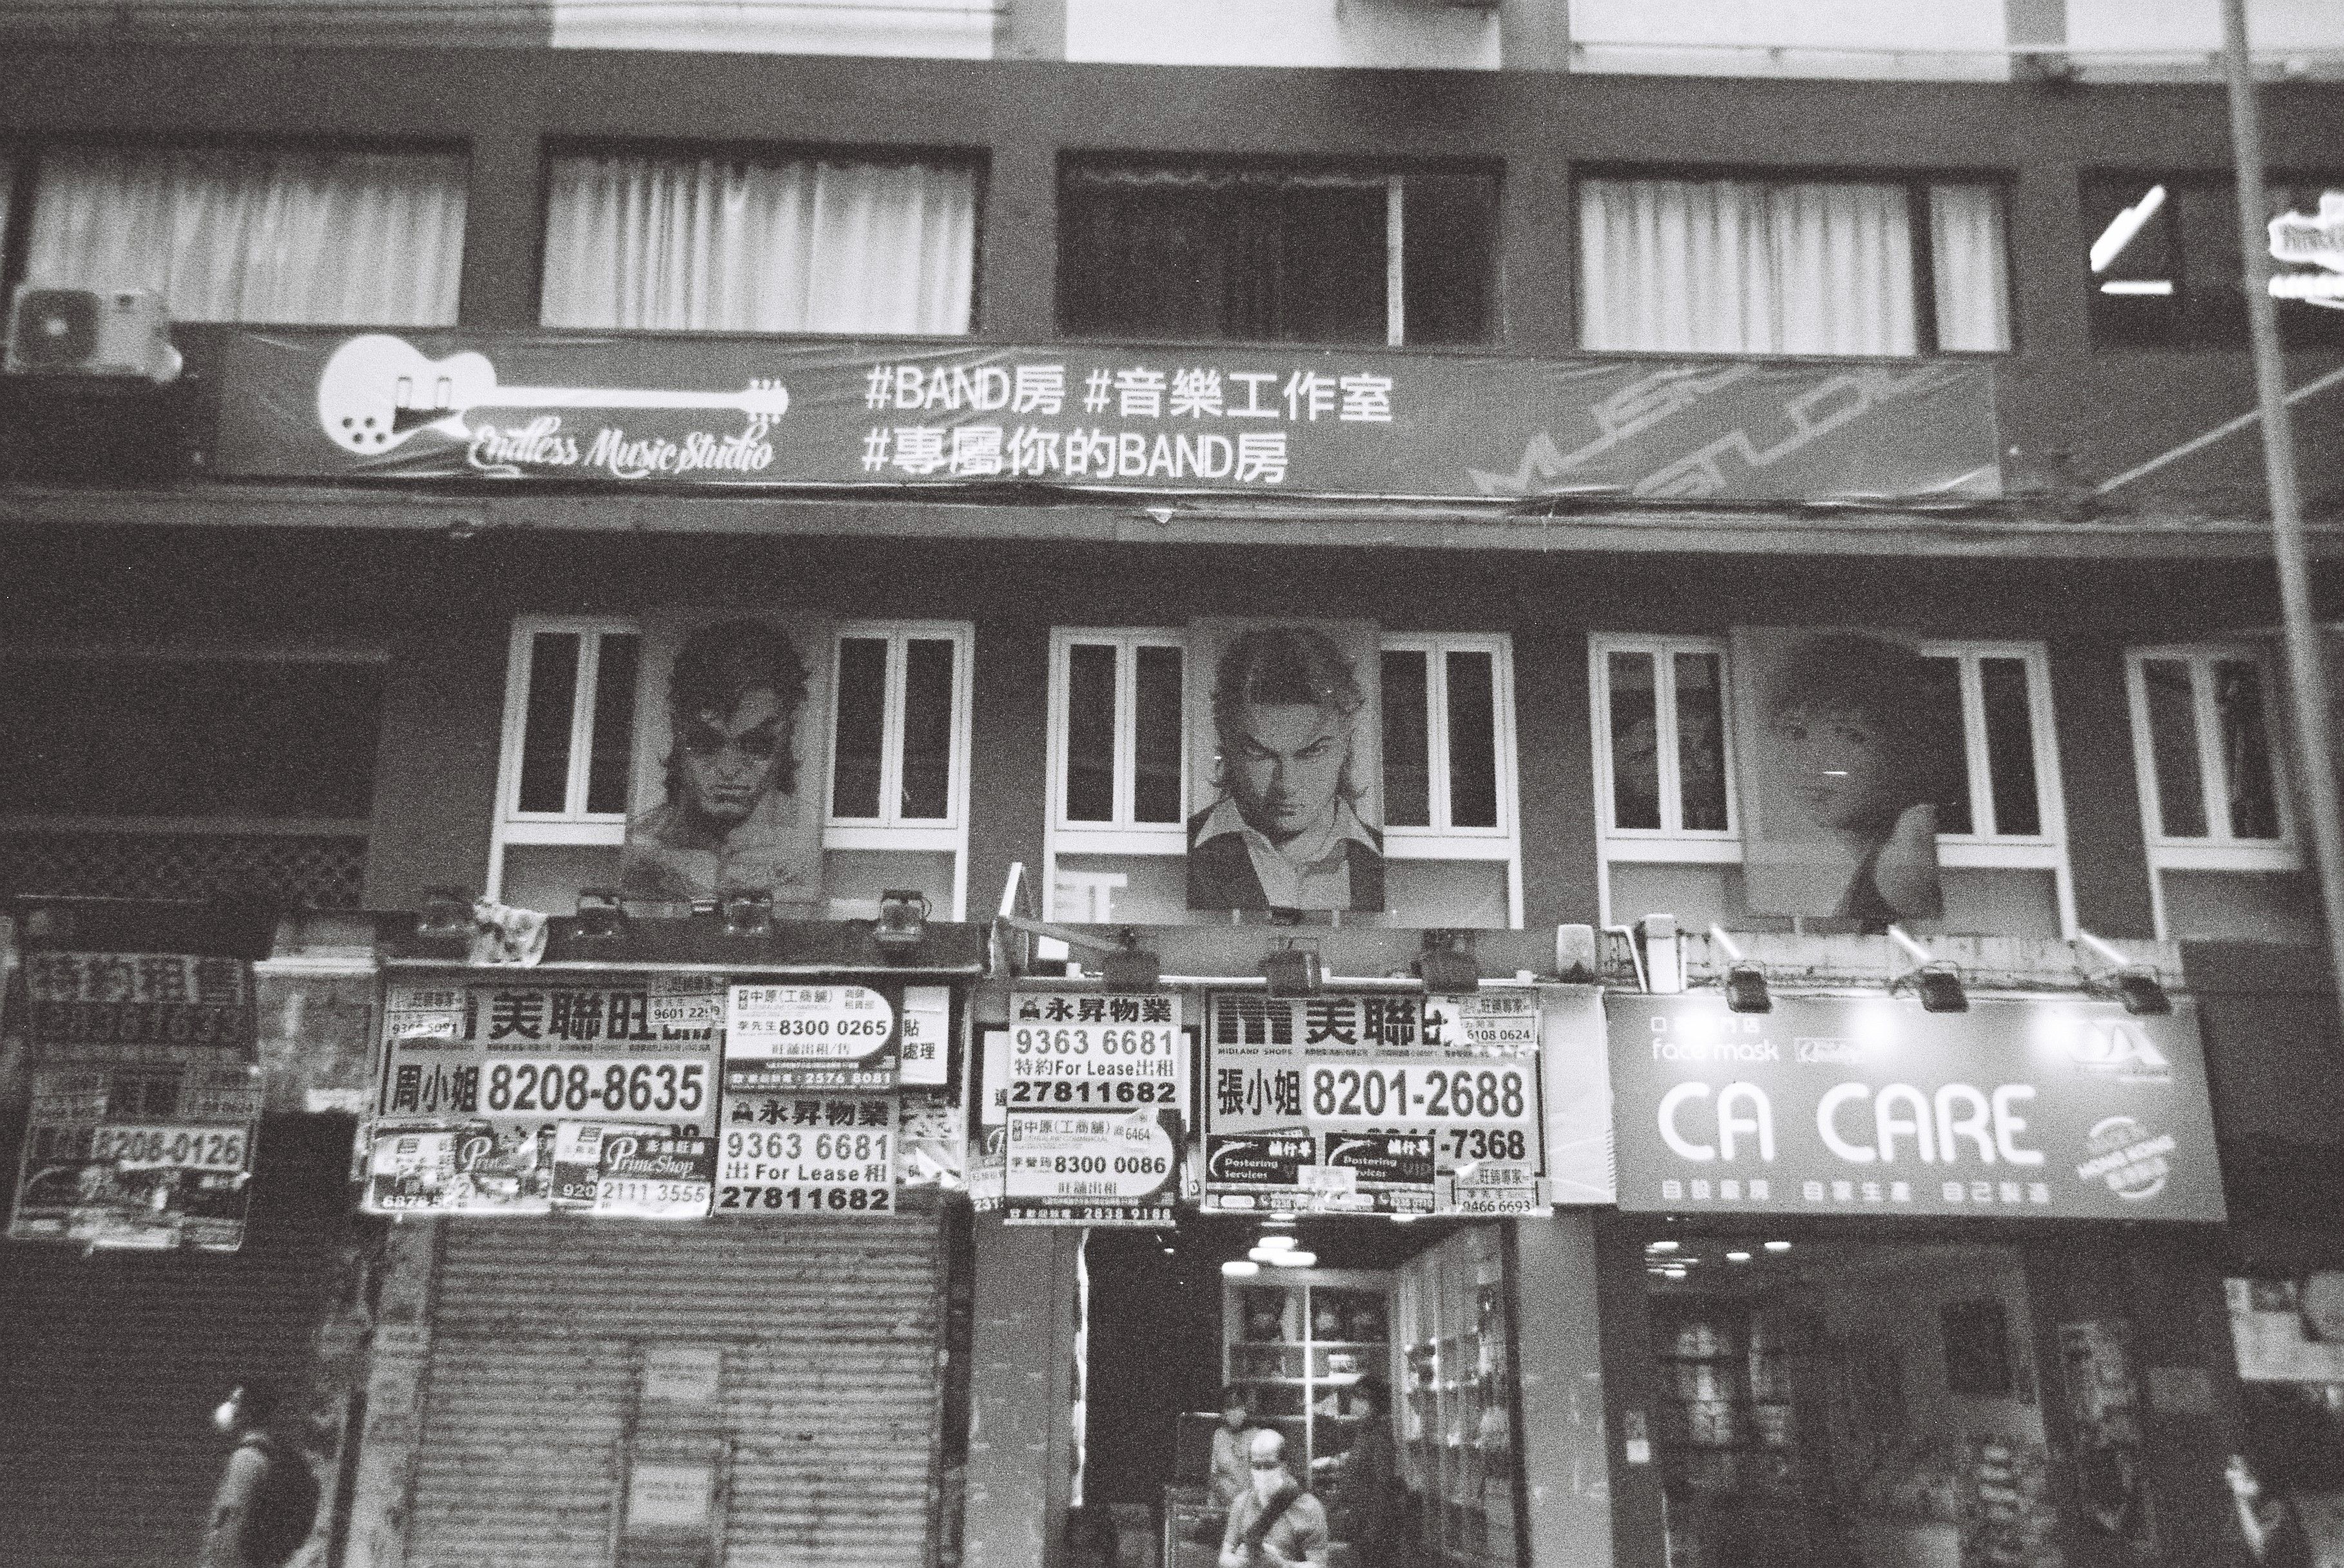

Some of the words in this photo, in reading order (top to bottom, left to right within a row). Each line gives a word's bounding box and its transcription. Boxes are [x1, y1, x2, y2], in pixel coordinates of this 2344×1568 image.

[865, 364, 1066, 416] #BAND房
[1085, 368, 1393, 423] #音樂工作室
[468, 416, 579, 478] Endless
[585, 428, 676, 479] Music
[677, 420, 773, 472] Studio
[862, 426, 1289, 485] #專屬你的BAND房
[1045, 997, 1172, 1023] 永昇物業
[779, 1020, 829, 1036] 8300
[837, 1020, 887, 1036] 0265
[1467, 1029, 1496, 1041] 6108
[1500, 1029, 1530, 1040] 0624
[1016, 1029, 1089, 1054] 9363
[1102, 1029, 1172, 1055] 6681
[1713, 1039, 1780, 1061] mask
[805, 1072, 845, 1084] 2576
[852, 1072, 891, 1084] 8081
[1014, 1059, 1053, 1075] 特約
[1055, 1061, 1082, 1076] For
[1087, 1061, 1134, 1076] Lease
[1136, 1059, 1173, 1078] 出租
[392, 1065, 479, 1111] 周小姐
[489, 1063, 704, 1110] 8208-8635
[1012, 1081, 1176, 1103] 27811682
[1217, 1069, 1302, 1116] 張小姐
[1313, 1069, 1524, 1118] 8201-2688
[760, 1099, 889, 1127] 永昇物業
[1658, 1081, 1775, 1162] CA
[1816, 1083, 2044, 1167] CARE
[728, 1132, 802, 1160] 9363
[816, 1132, 887, 1161] 6681
[1125, 1128, 1150, 1141] 6464
[756, 1165, 790, 1180] For
[799, 1165, 859, 1182] Lease
[1055, 1156, 1107, 1174] 8300
[1114, 1156, 1166, 1174] 0086
[601, 1182, 649, 1201] 2111
[720, 1186, 889, 1211] 27811682
